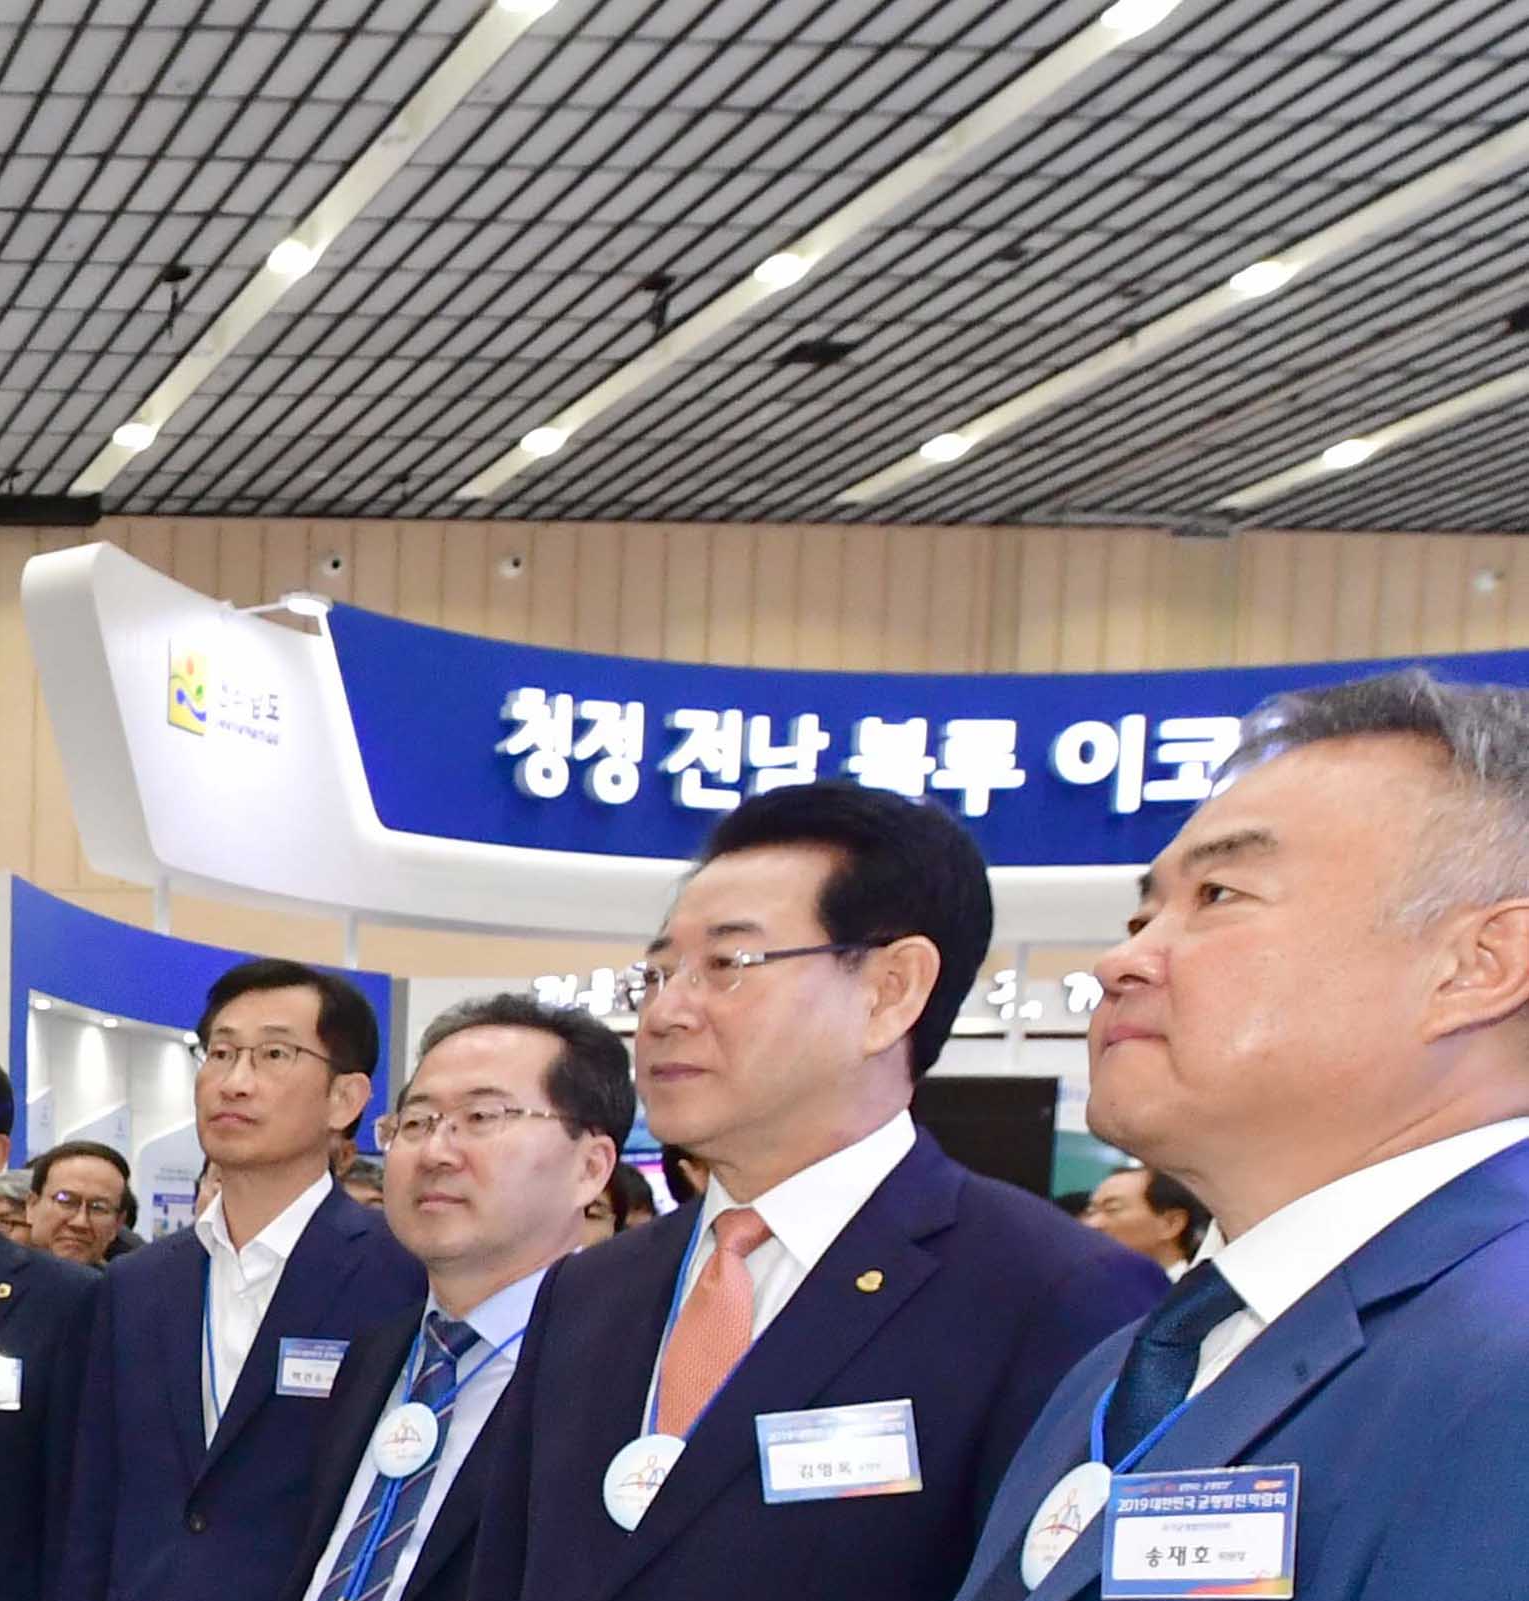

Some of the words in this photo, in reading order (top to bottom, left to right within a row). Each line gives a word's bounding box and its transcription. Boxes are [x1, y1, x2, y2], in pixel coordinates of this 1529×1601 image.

[496, 686, 645, 805] 청정
[664, 705, 831, 811] 전남
[1145, 1545, 1211, 1568] 송재호
